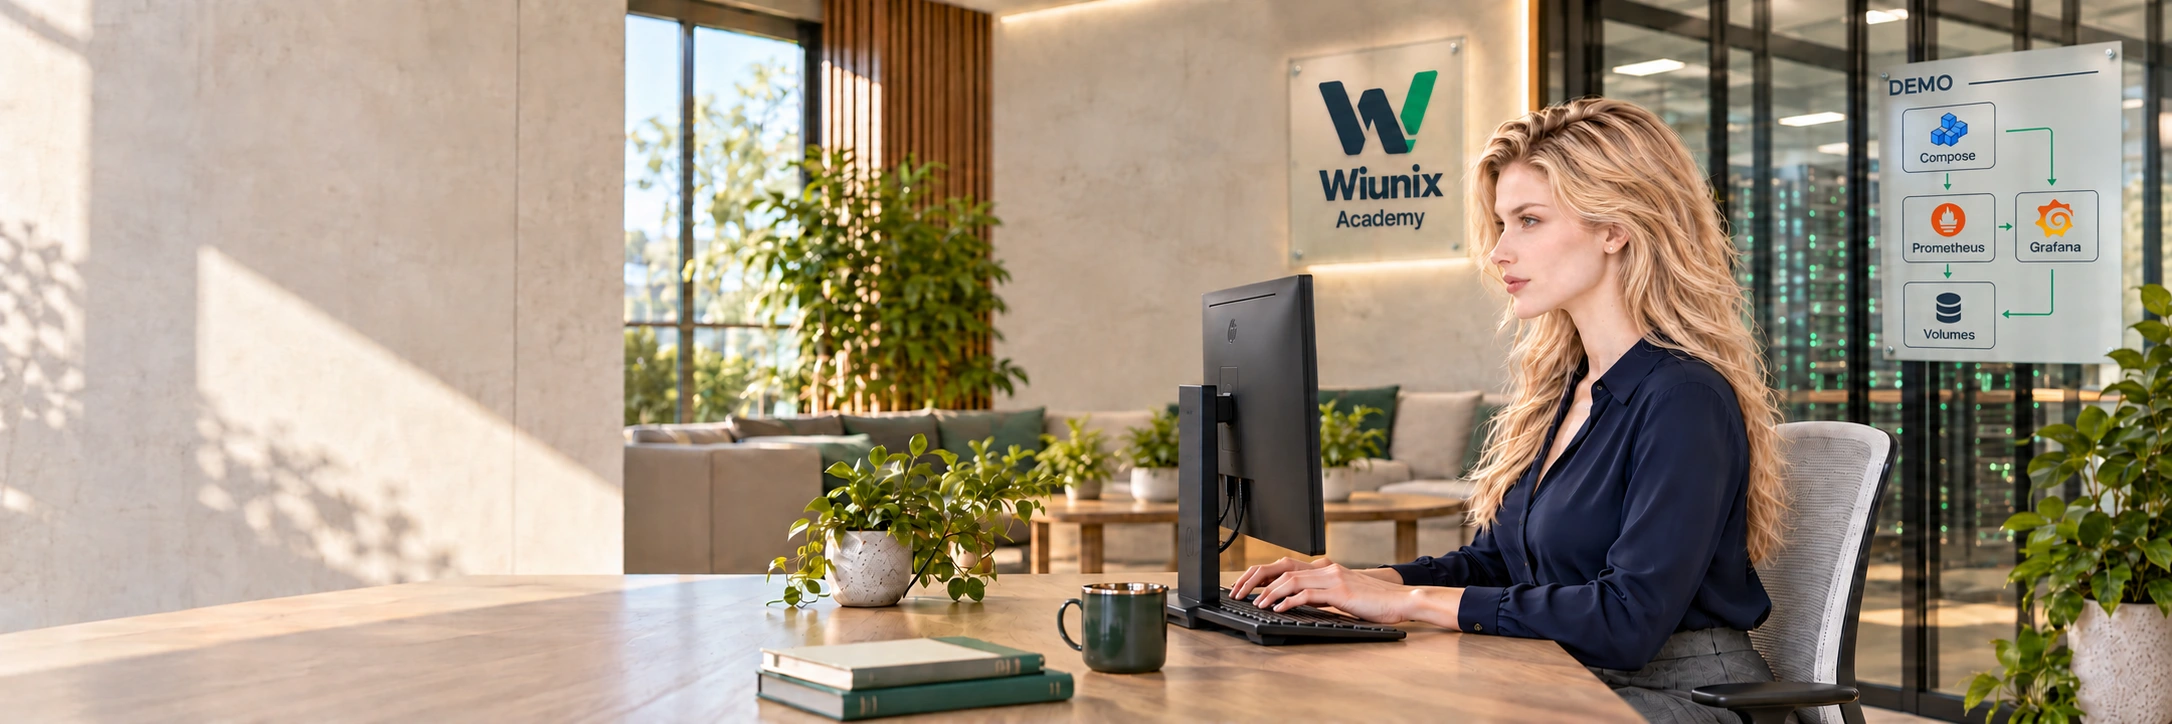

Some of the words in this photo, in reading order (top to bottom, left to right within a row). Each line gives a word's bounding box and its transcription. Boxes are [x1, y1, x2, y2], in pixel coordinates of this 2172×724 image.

[1889, 74, 1953, 96] DEMO
[1919, 151, 1976, 164] Compose
[1319, 164, 1443, 201] Wiunix
[1336, 209, 1425, 230] Academy
[1912, 242, 1985, 254] Prometheus
[2029, 241, 2082, 253] Grafana
[1923, 328, 1975, 340] Volumes
